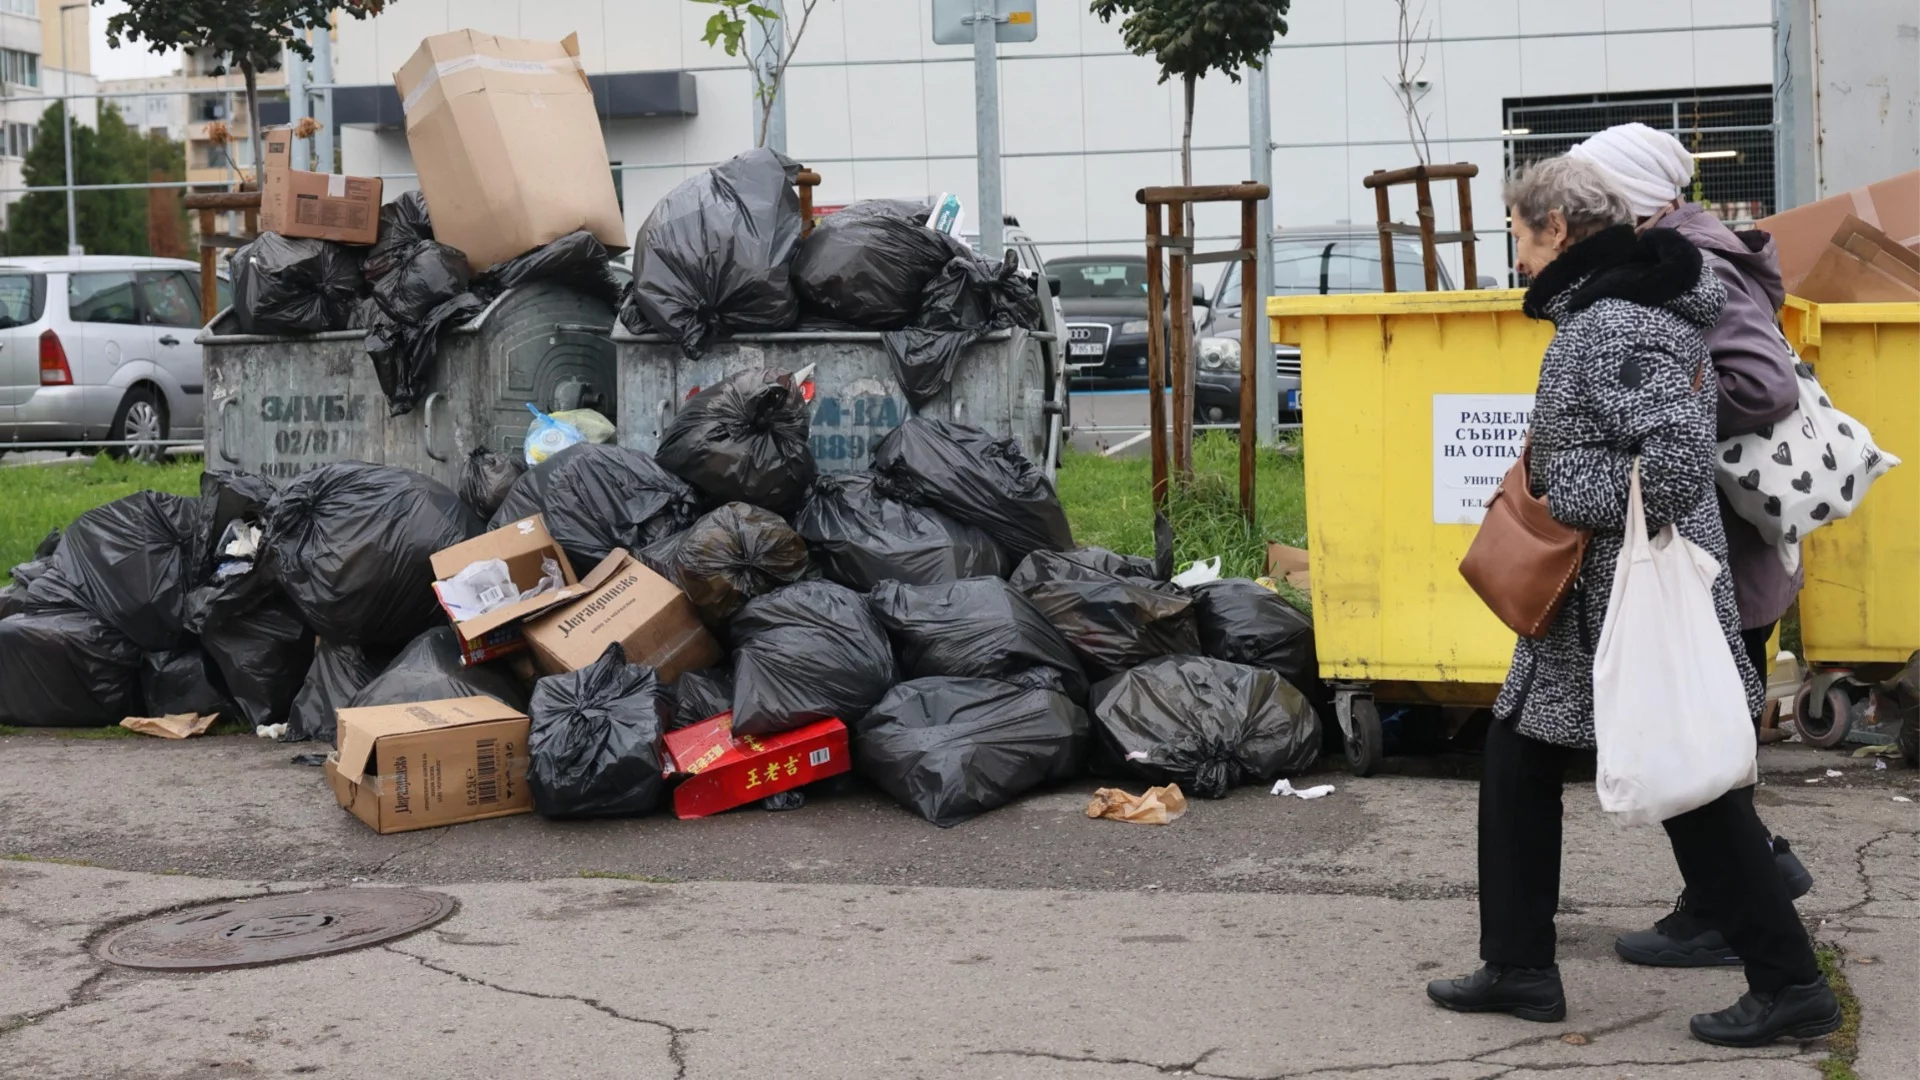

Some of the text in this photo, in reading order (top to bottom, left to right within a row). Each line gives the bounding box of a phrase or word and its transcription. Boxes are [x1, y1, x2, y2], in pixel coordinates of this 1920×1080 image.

[1444, 445, 1467, 457] НА
[745, 756, 799, 790] 王老吉
